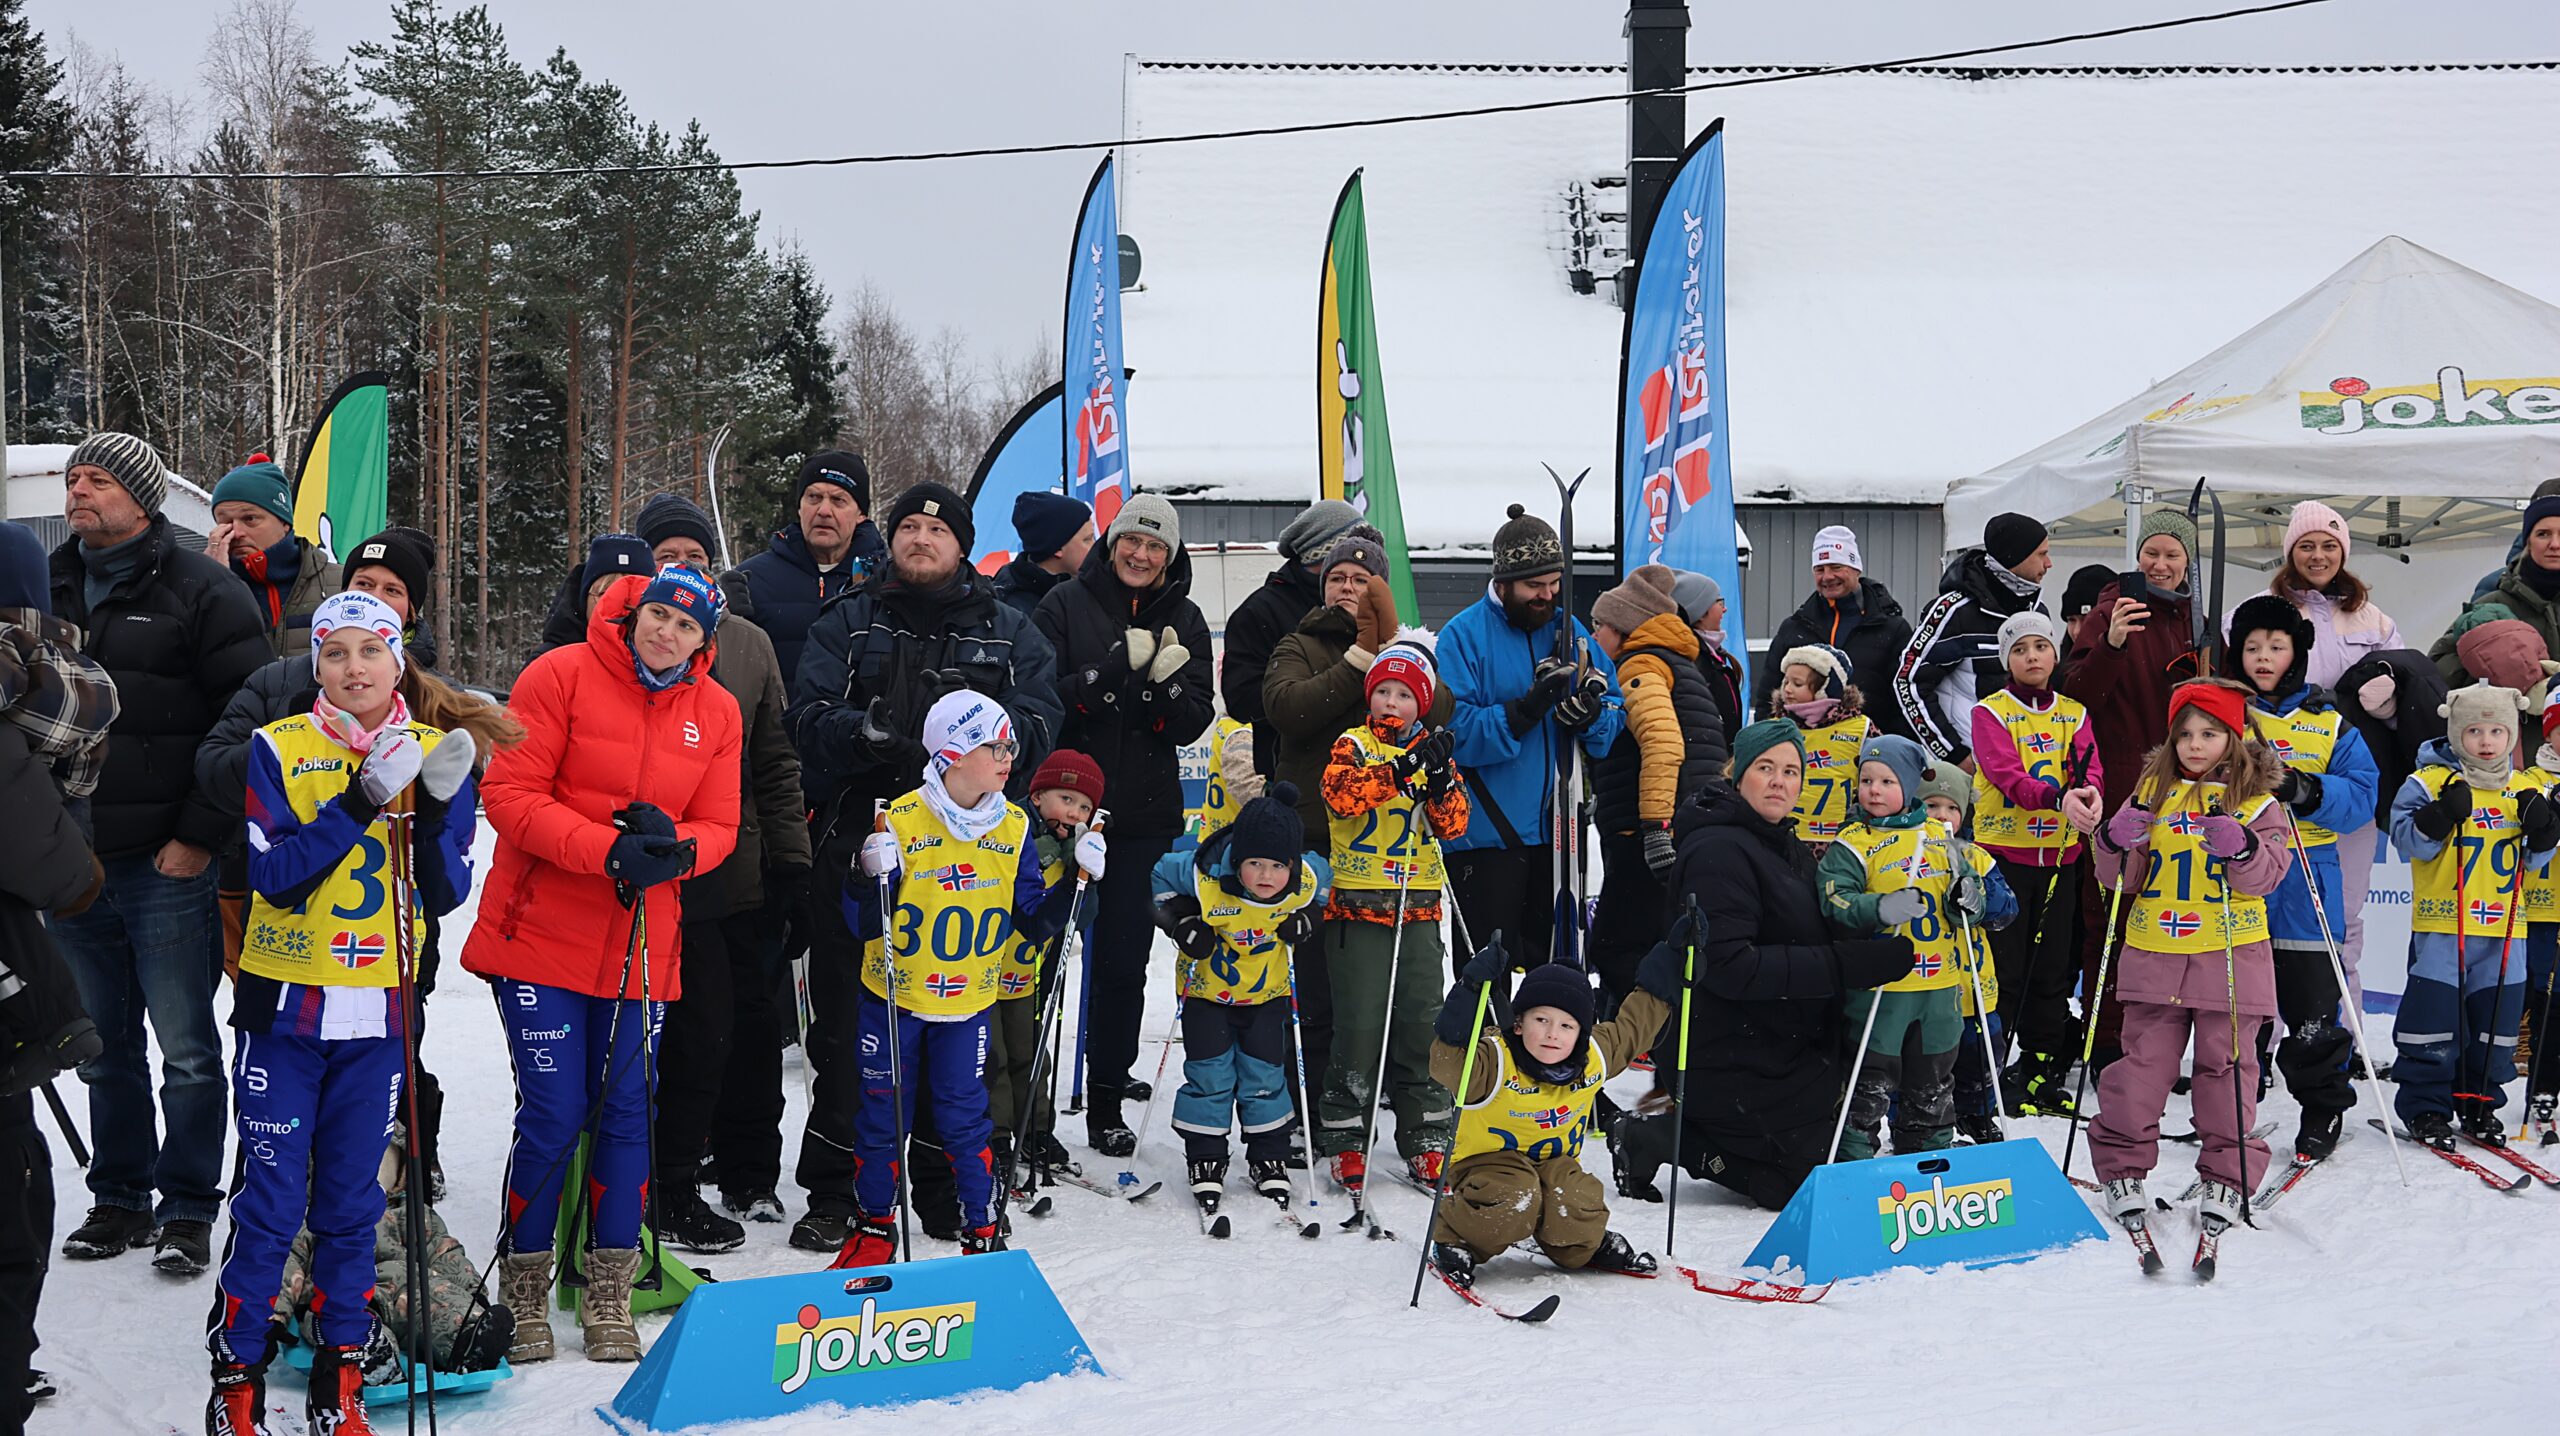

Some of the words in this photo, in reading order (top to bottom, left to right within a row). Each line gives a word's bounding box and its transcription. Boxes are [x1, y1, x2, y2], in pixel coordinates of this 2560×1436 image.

[661, 569, 708, 594] SpareBank
[343, 595, 378, 608] MAPEI
[958, 702, 984, 727] MAPEI
[2293, 720, 2330, 736] joker
[292, 757, 342, 778] joker
[892, 801, 919, 815] ATEX
[908, 836, 941, 855] joer
[978, 834, 1013, 854] joker
[2452, 836, 2519, 895] 79
[2141, 848, 2233, 904] 215
[1208, 903, 1241, 918] oker
[398, 878, 412, 978] SWIX
[892, 902, 1017, 962] 300
[884, 913, 894, 979] SWIX
[521, 1028, 566, 1041] Emmto
[1571, 1072, 1601, 1092] jker
[1888, 1175, 2005, 1254] joker
[861, 1225, 888, 1236] alpina
[780, 1297, 964, 1394] joker
[218, 1373, 245, 1384] alpina
